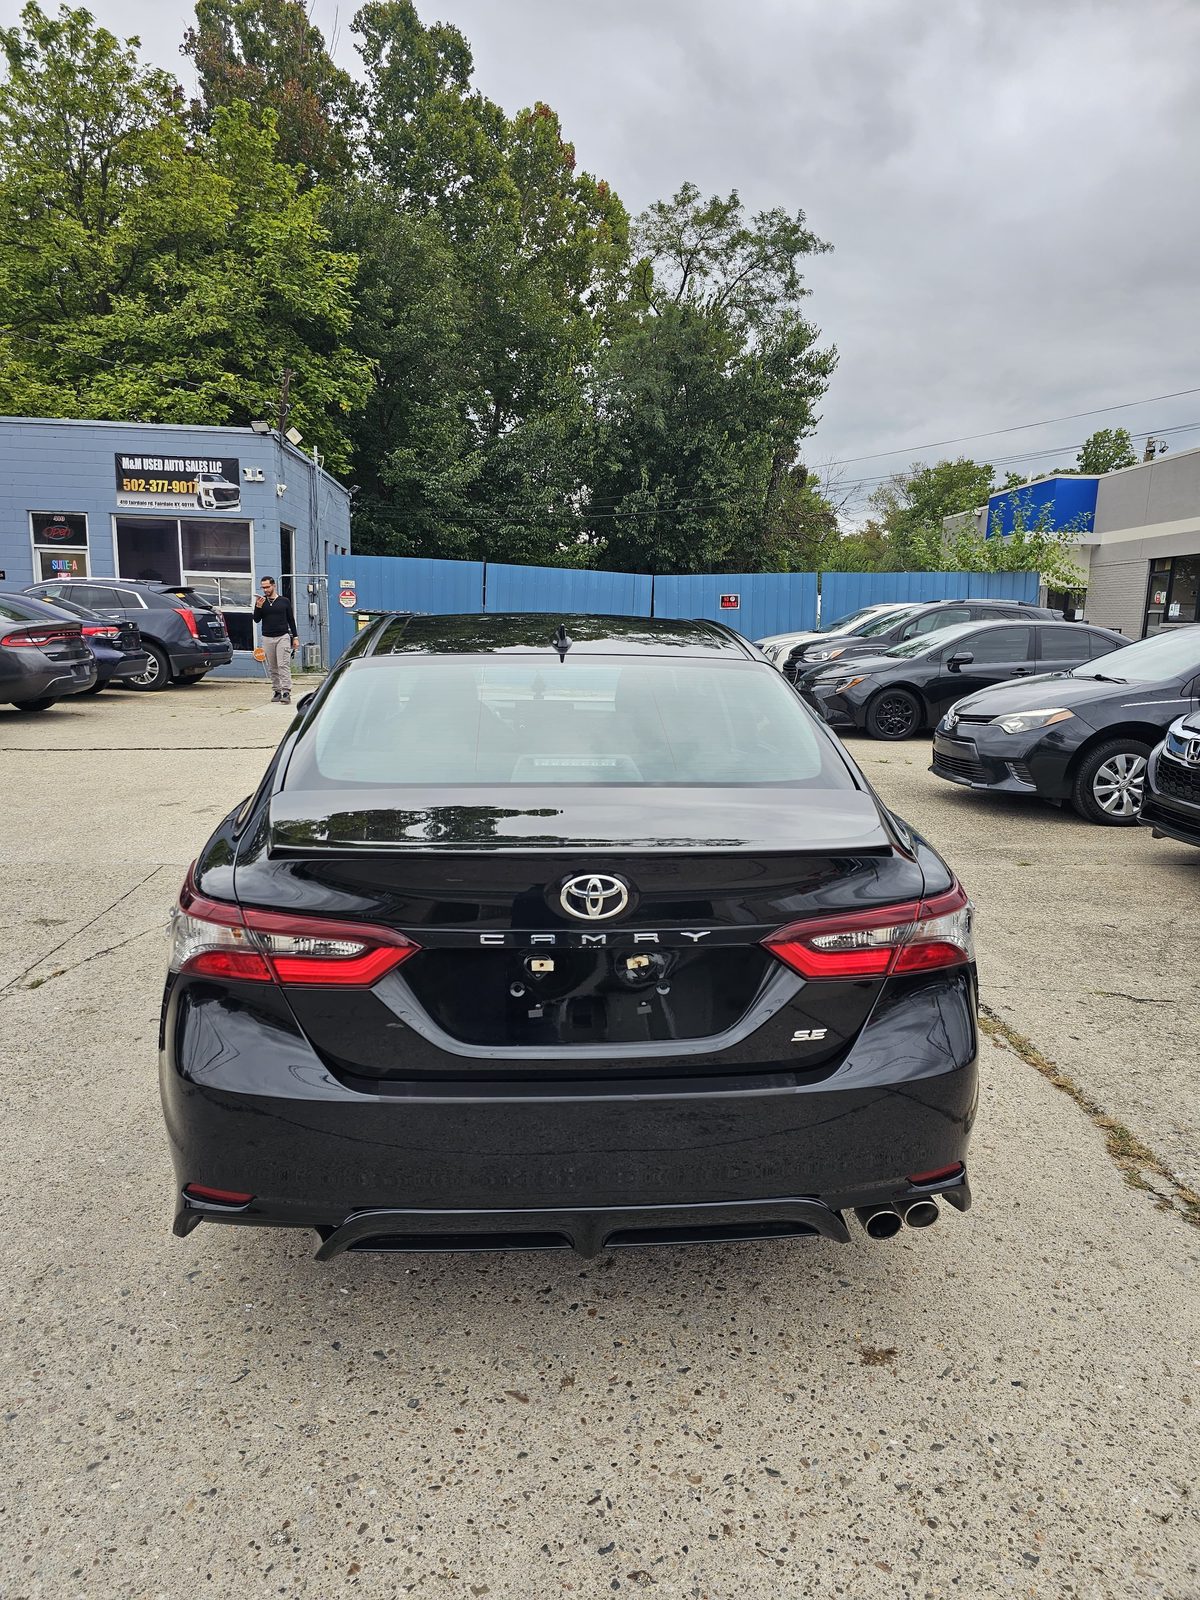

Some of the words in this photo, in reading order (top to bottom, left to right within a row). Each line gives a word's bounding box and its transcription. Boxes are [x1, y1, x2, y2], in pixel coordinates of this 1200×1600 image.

[122, 457, 142, 470] M&M
[143, 458, 163, 471] USED
[164, 459, 185, 472] AUTO
[185, 460, 208, 473] SALES
[209, 461, 222, 473] LLC
[52, 559, 78, 570] SUITE-A
[479, 930, 711, 945] CAMRY
[790, 1028, 828, 1042] SE
